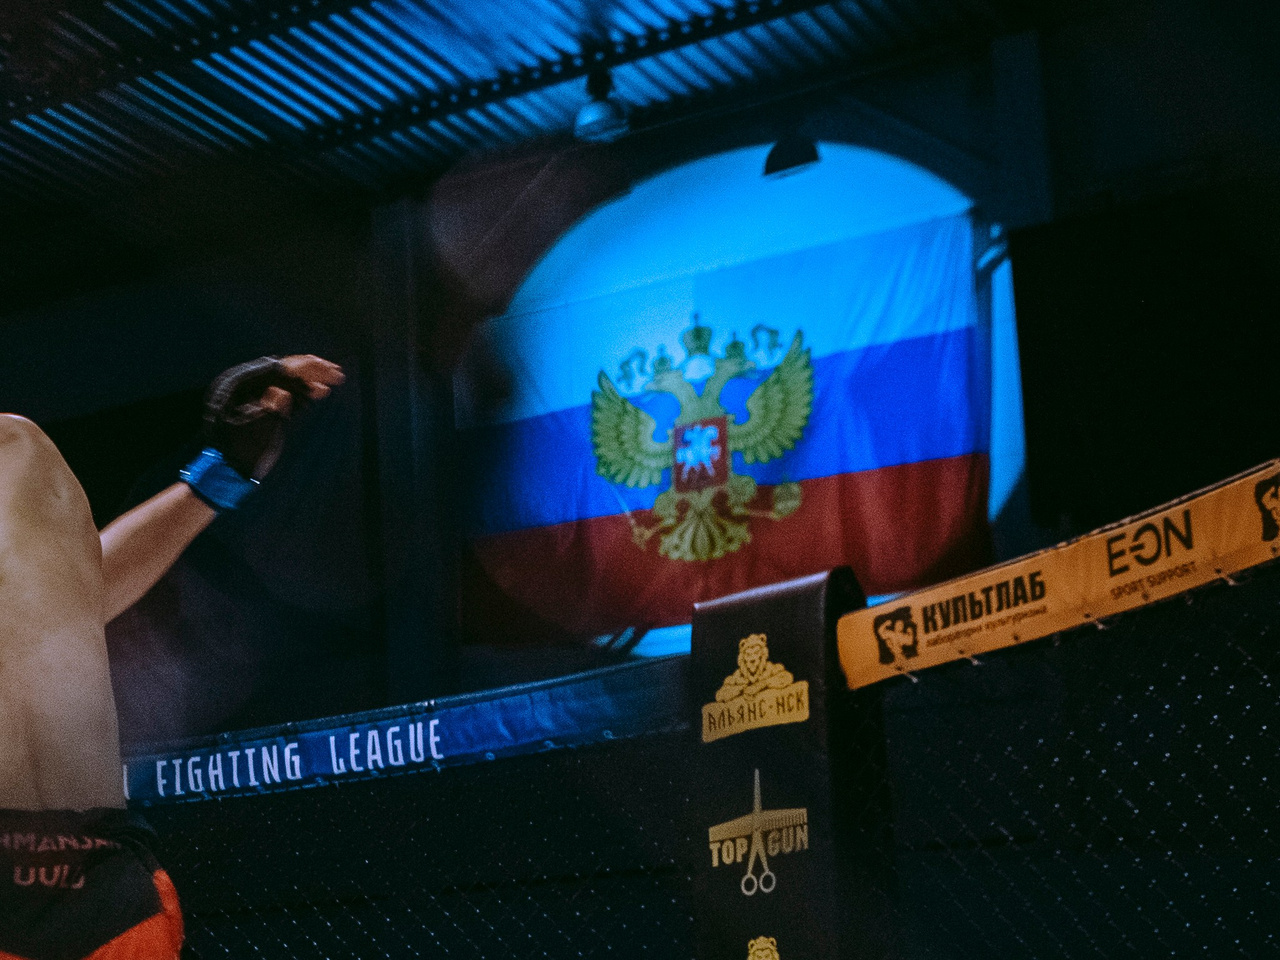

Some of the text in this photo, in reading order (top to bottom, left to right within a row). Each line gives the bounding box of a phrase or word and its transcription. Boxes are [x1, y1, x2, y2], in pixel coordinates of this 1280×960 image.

[707, 690, 805, 733] АЛЬЯНС-НСК
[155, 741, 303, 798] FIGHTING
[329, 718, 445, 776] LEAGUE
[709, 824, 809, 868] TOP GUN
